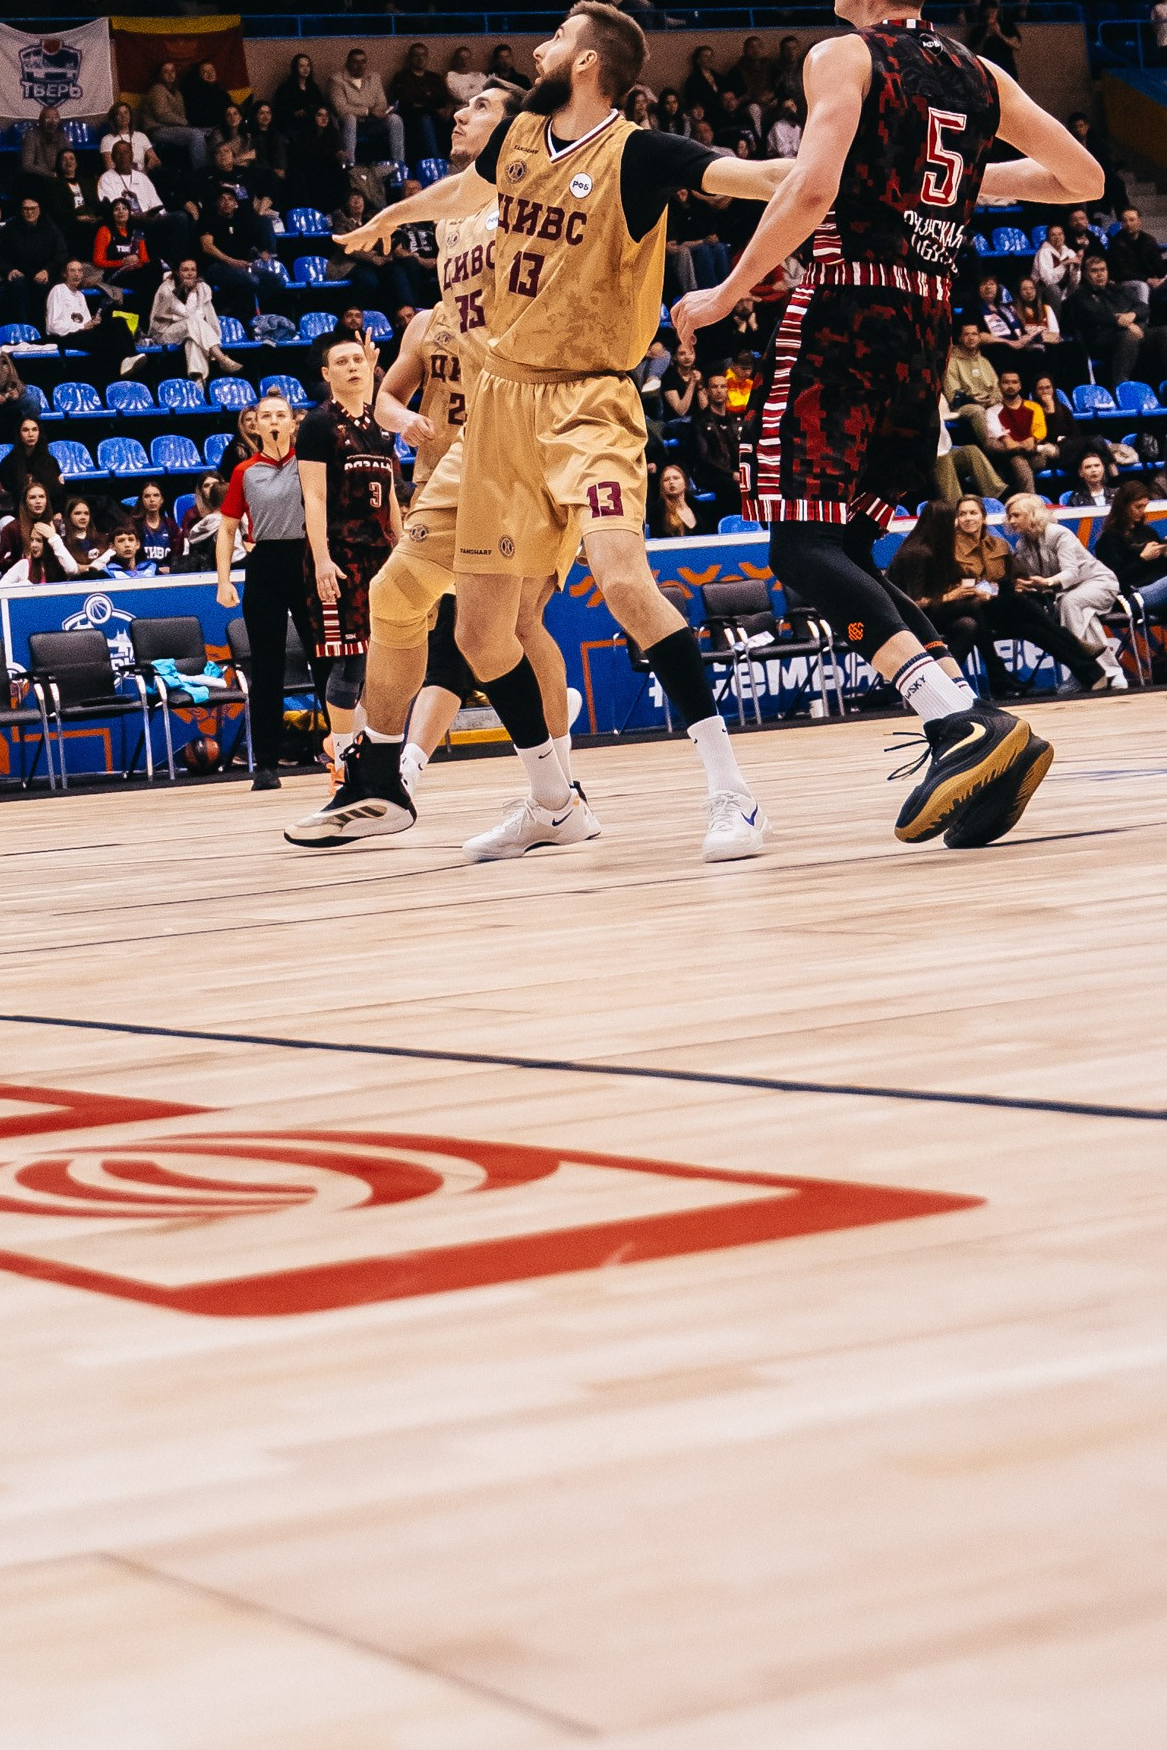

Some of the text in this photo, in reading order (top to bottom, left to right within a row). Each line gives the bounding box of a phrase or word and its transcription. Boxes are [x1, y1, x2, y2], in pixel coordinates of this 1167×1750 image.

[21, 80, 83, 100] ТВЕРЬ
[920, 106, 968, 207] 5
[572, 180, 590, 191] РФБ
[498, 192, 588, 246] ЦИВС
[508, 250, 545, 298] 13
[454, 289, 487, 334] 35
[368, 481, 382, 508] 3
[586, 481, 624, 519] 13
